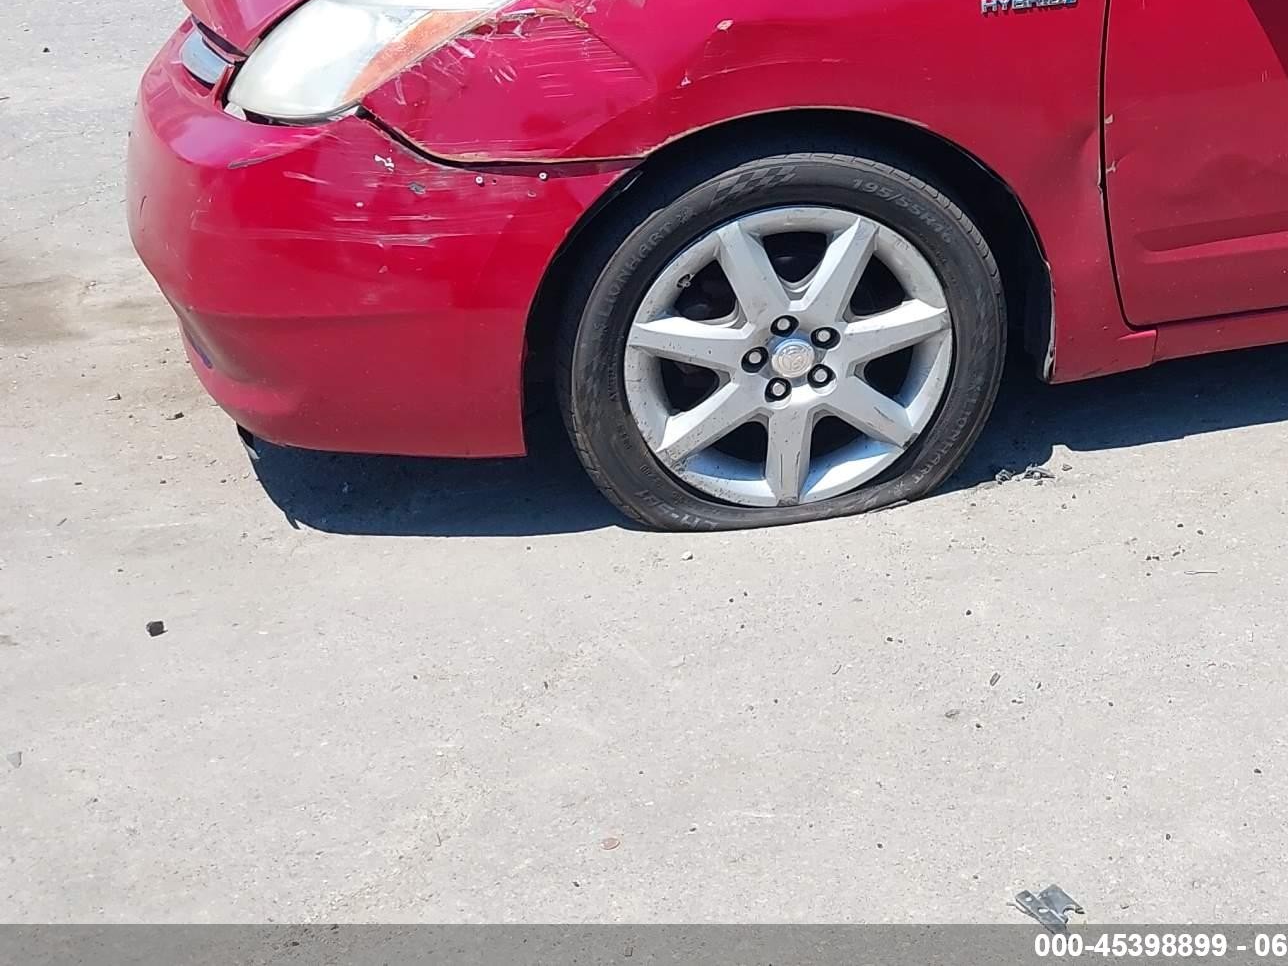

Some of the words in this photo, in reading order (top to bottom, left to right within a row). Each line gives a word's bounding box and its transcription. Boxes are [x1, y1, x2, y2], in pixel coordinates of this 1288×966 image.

[852, 177, 953, 244] 195/55R16
[598, 221, 673, 318] LIONHART
[911, 397, 978, 484] LIONHART
